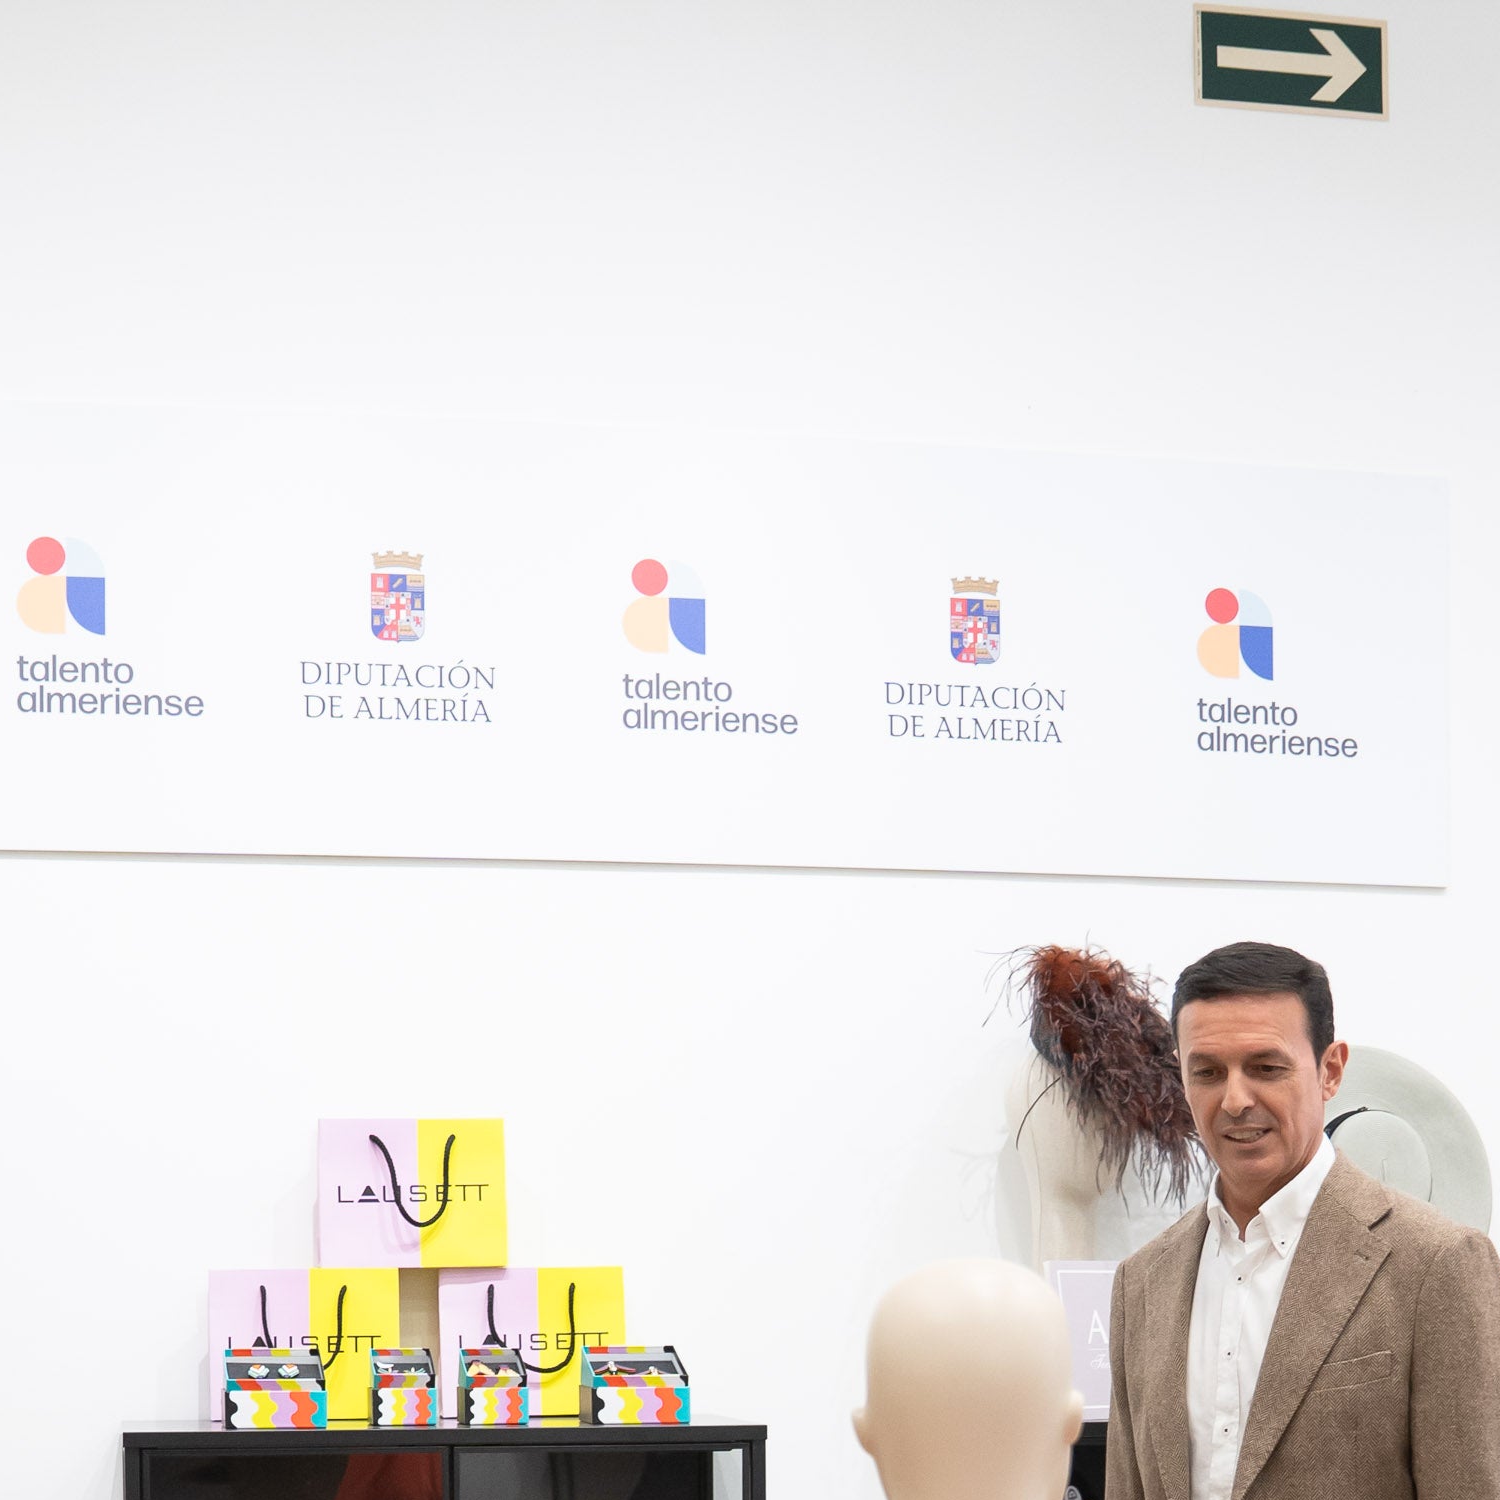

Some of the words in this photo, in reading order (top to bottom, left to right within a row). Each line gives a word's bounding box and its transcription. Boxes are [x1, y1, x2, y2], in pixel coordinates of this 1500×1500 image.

[17, 654, 133, 684] talento
[300, 660, 495, 689] DIPUTACIÓN
[17, 685, 204, 716] almeriense
[622, 673, 732, 702] talento
[884, 682, 1065, 711] DIPUTACIÓN
[304, 695, 343, 718] DE
[353, 693, 492, 722] ALMERÍA
[622, 703, 798, 734] almeriense
[1197, 697, 1298, 726] talento
[888, 714, 924, 737] DE
[934, 714, 1062, 743] ALMERÍA
[1197, 727, 1358, 758] almeriense
[338, 1184, 489, 1203] LAUSETT
